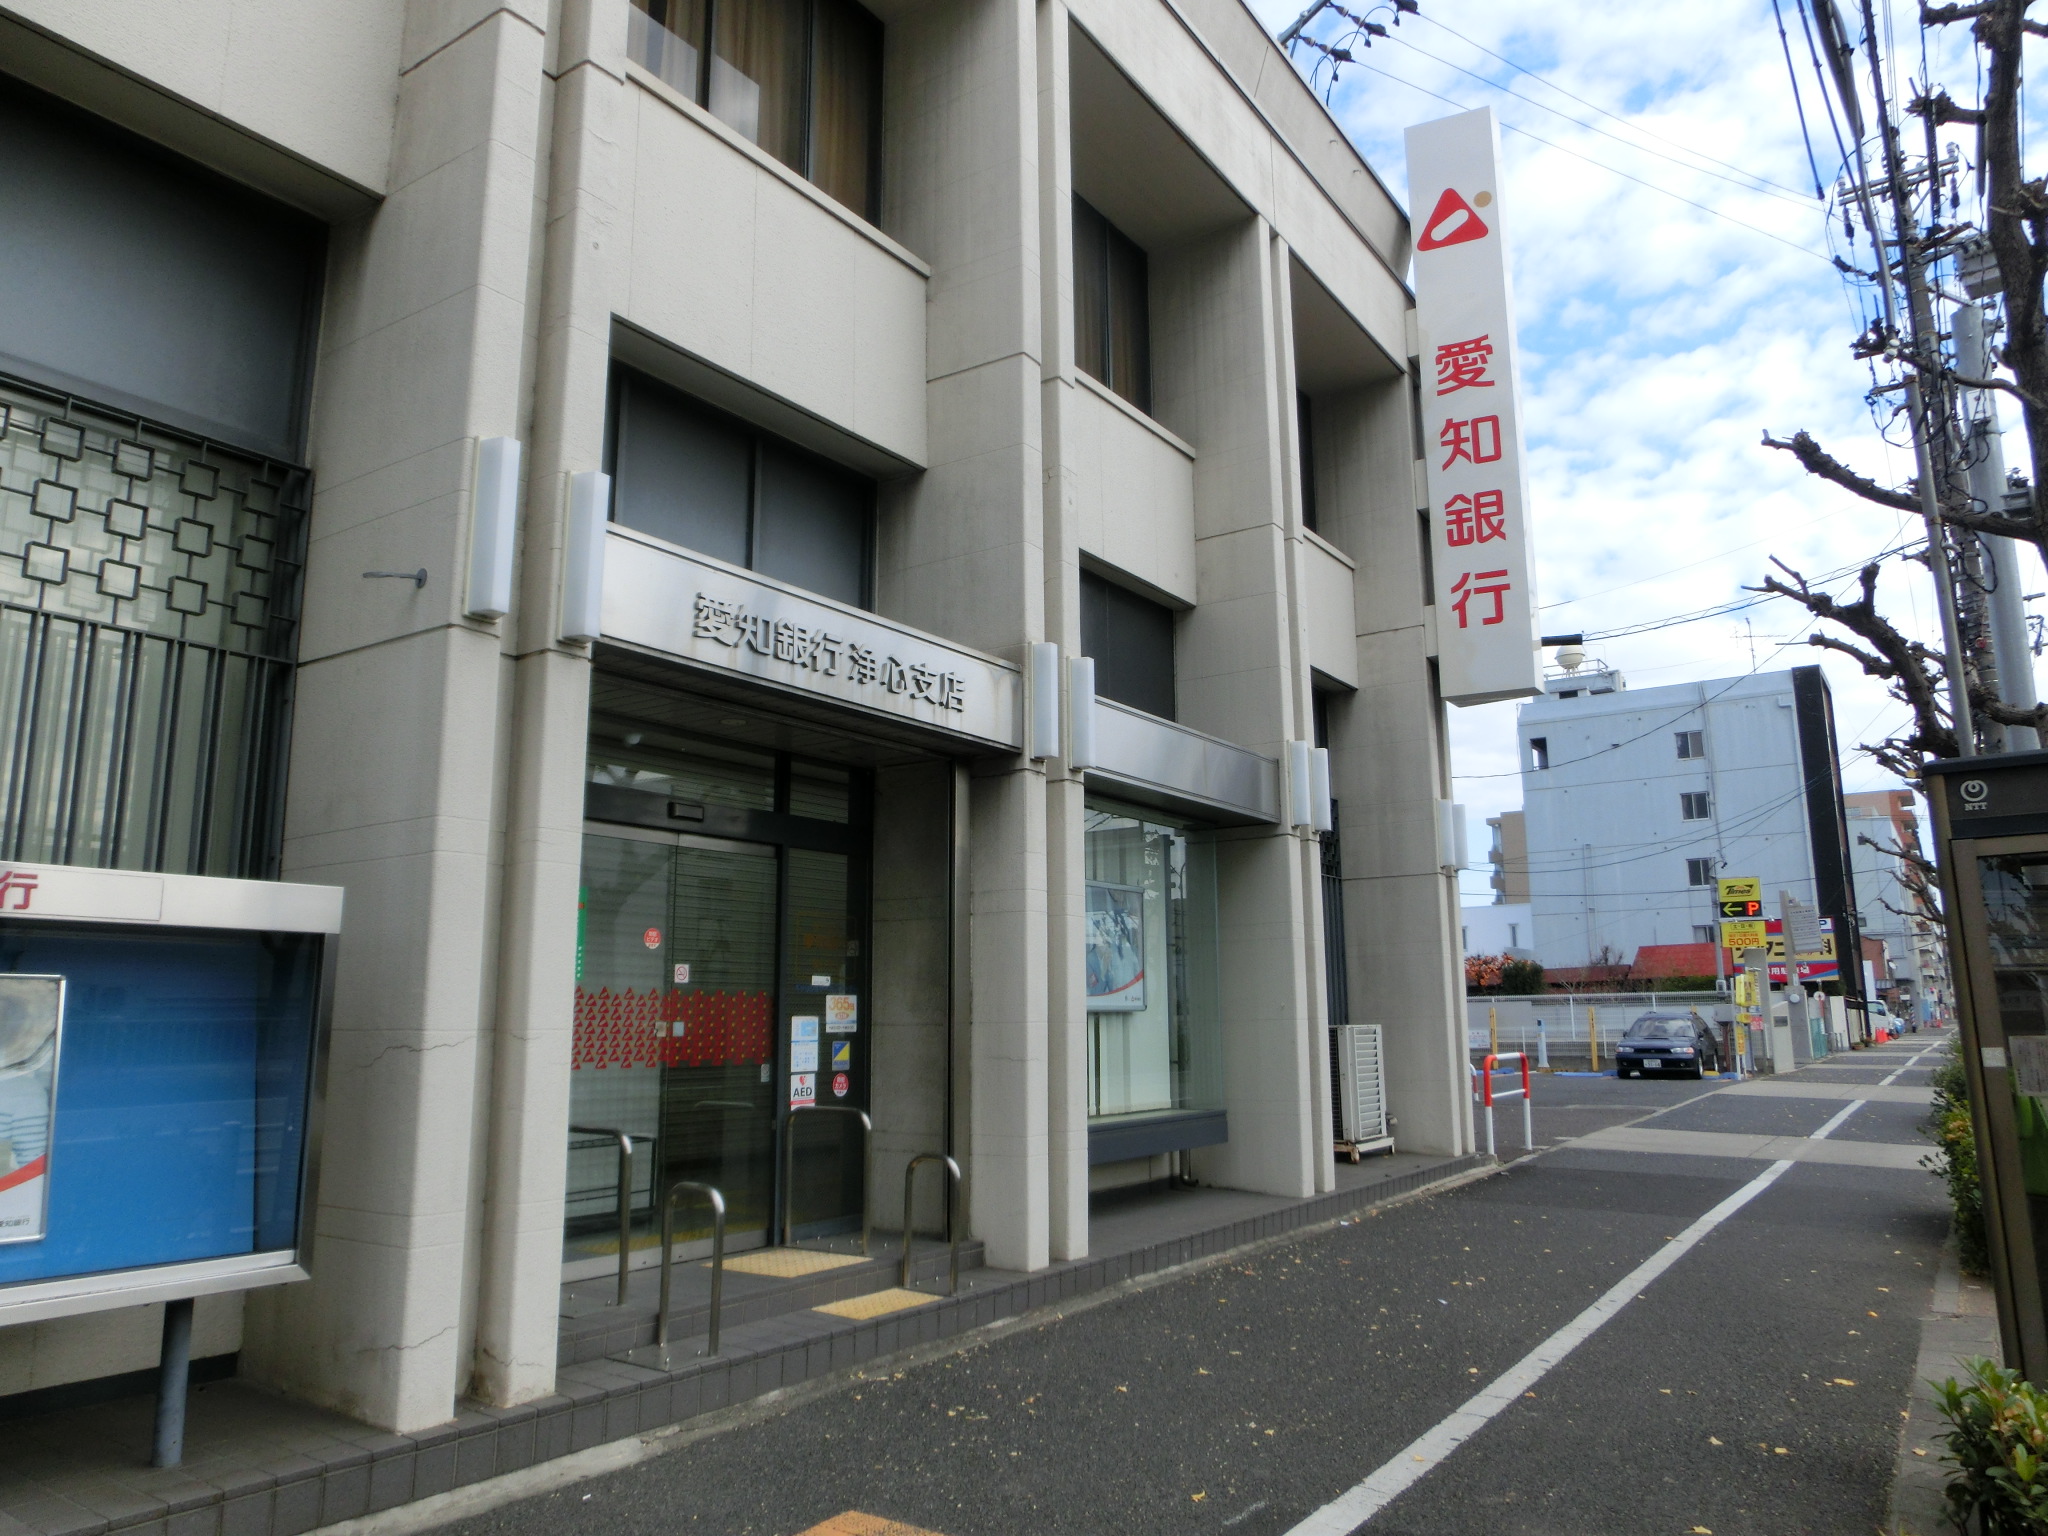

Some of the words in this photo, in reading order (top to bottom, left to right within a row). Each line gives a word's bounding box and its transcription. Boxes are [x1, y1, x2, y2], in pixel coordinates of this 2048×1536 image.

[1435, 333, 1511, 629] 愛知銀行
[1964, 801, 1988, 811] NTT
[0, 870, 39, 910] 行
[1725, 884, 1754, 895] Times
[1748, 902, 1760, 916] P
[1728, 938, 1760, 946] 500円
[793, 1086, 813, 1098] AED
